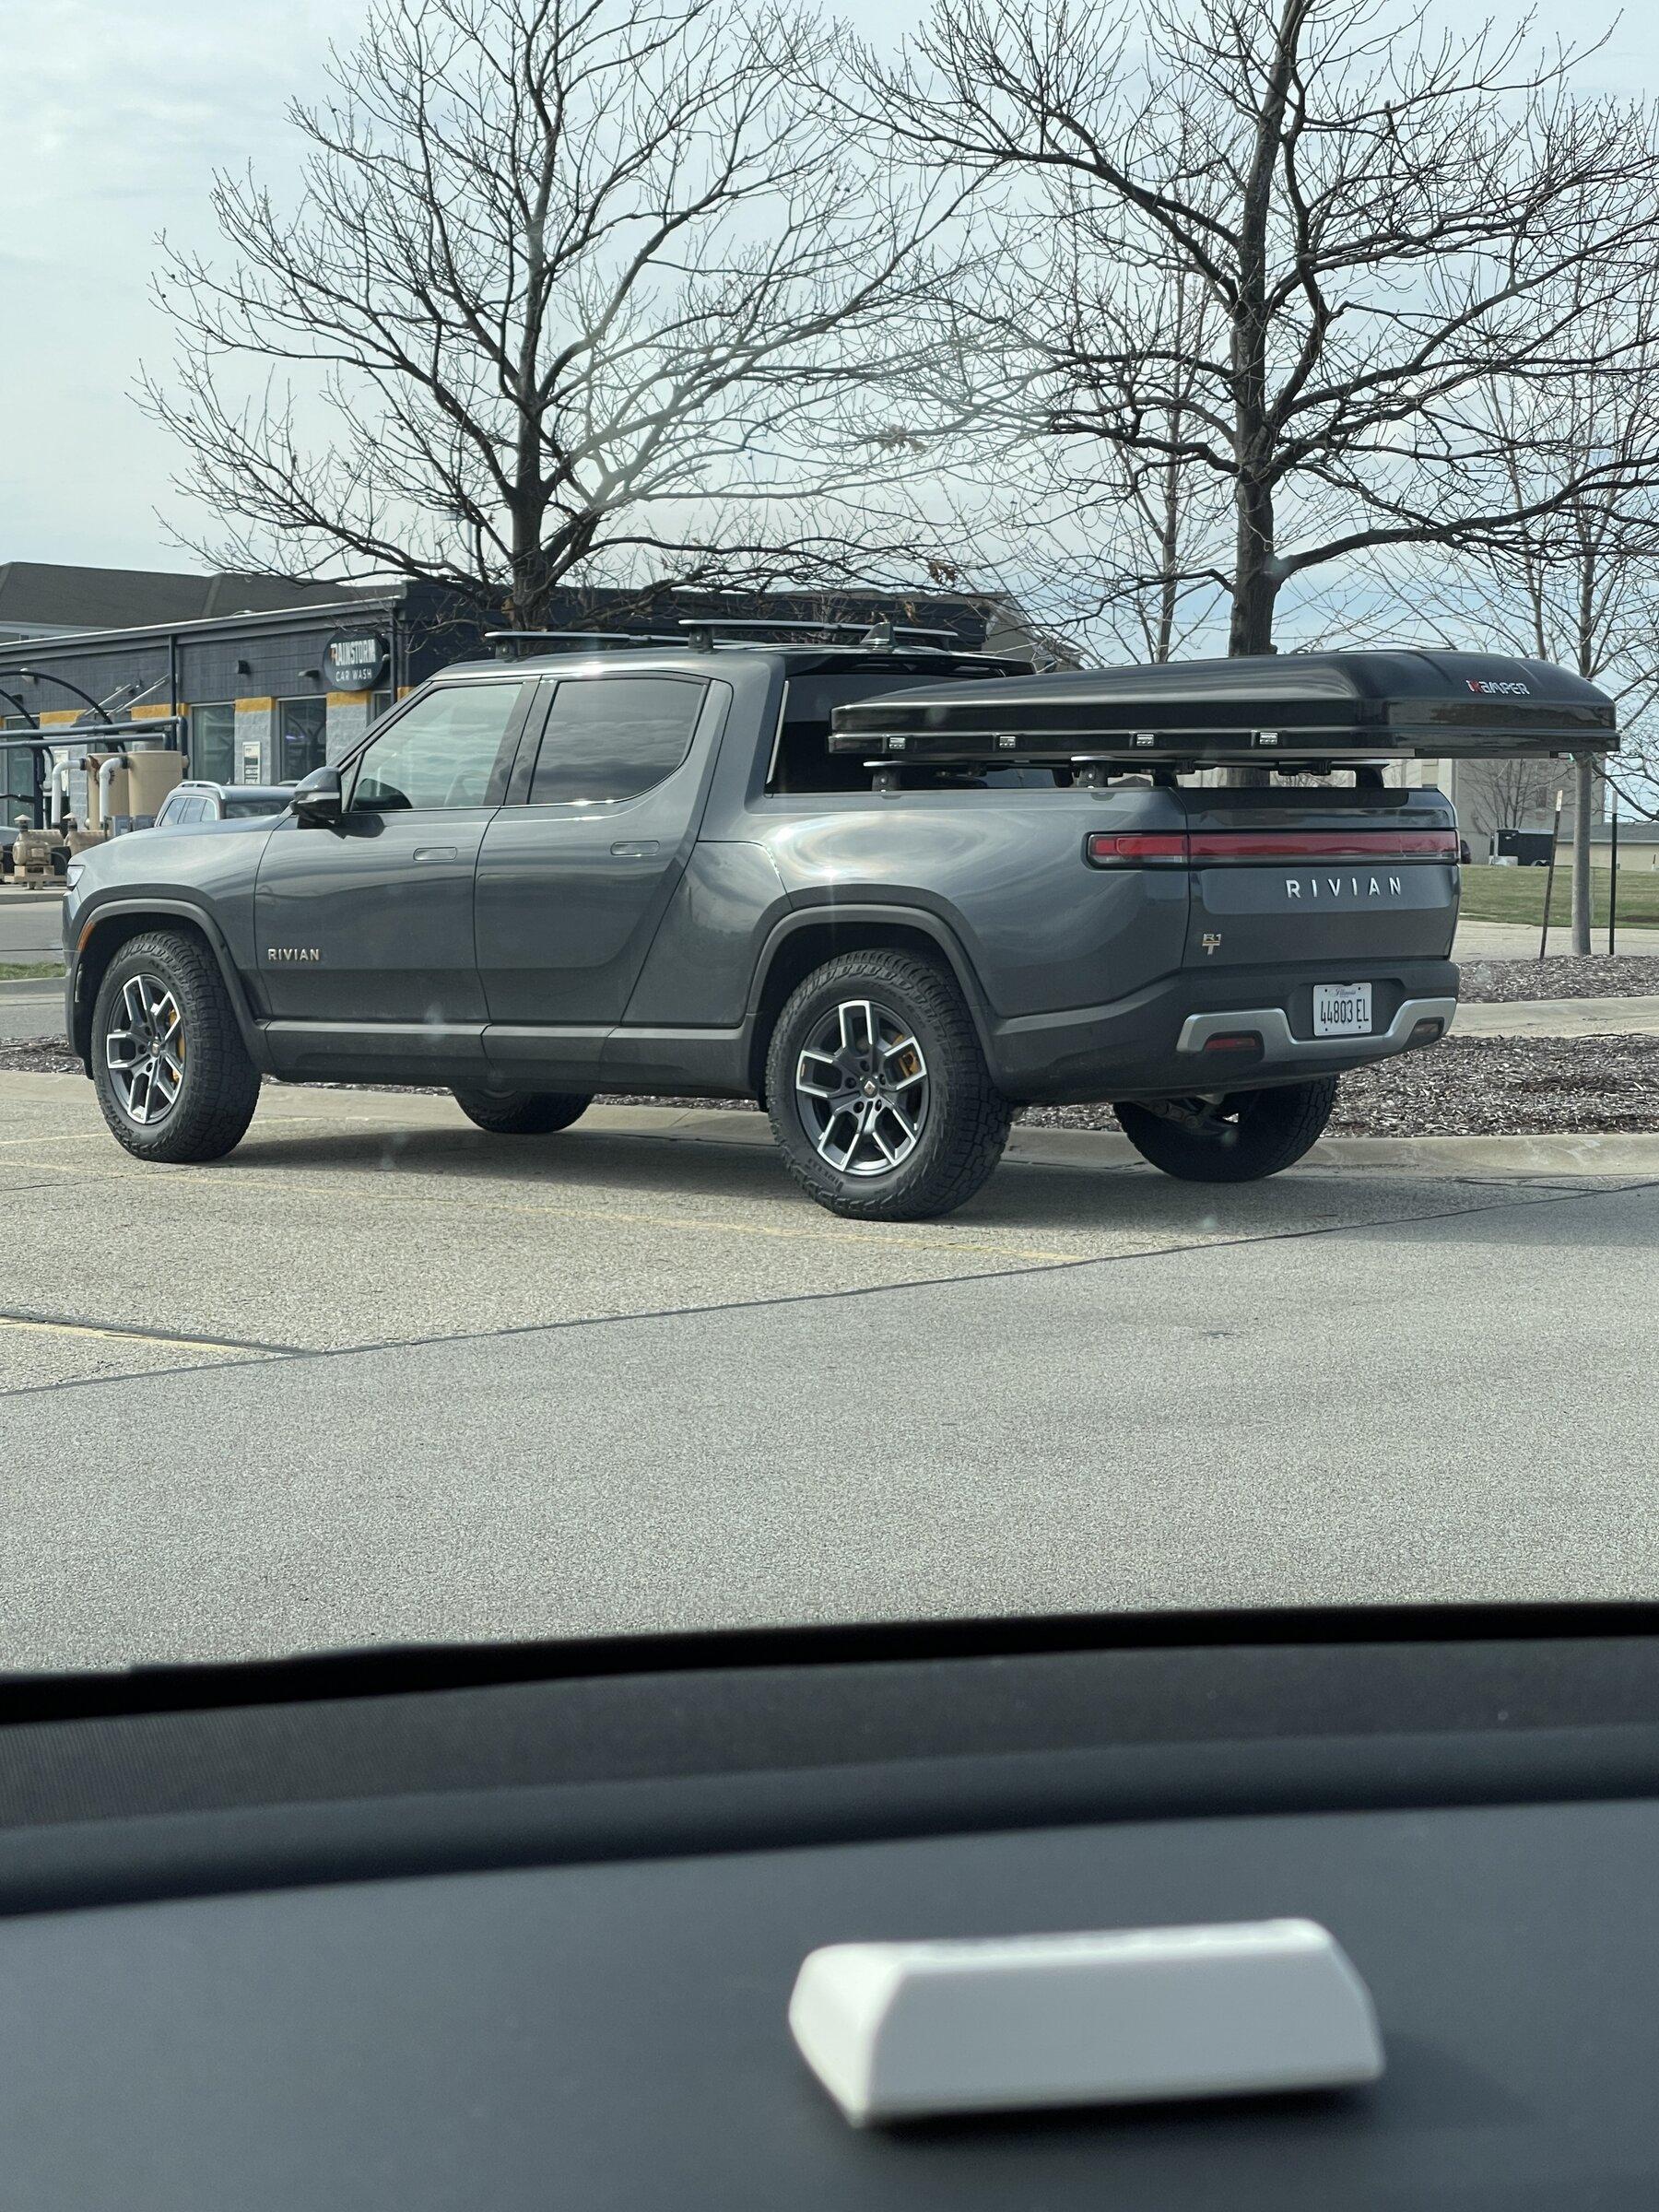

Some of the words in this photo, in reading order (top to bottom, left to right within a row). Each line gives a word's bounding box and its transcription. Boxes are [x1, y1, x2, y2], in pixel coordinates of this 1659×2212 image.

[335, 670, 349, 682] CAR
[352, 668, 372, 680] WASH
[1285, 877, 1402, 899] RIVIAN
[267, 948, 320, 960] RIVIAN
[1320, 1000, 1353, 1024] 44803
[1356, 998, 1370, 1023] EL
